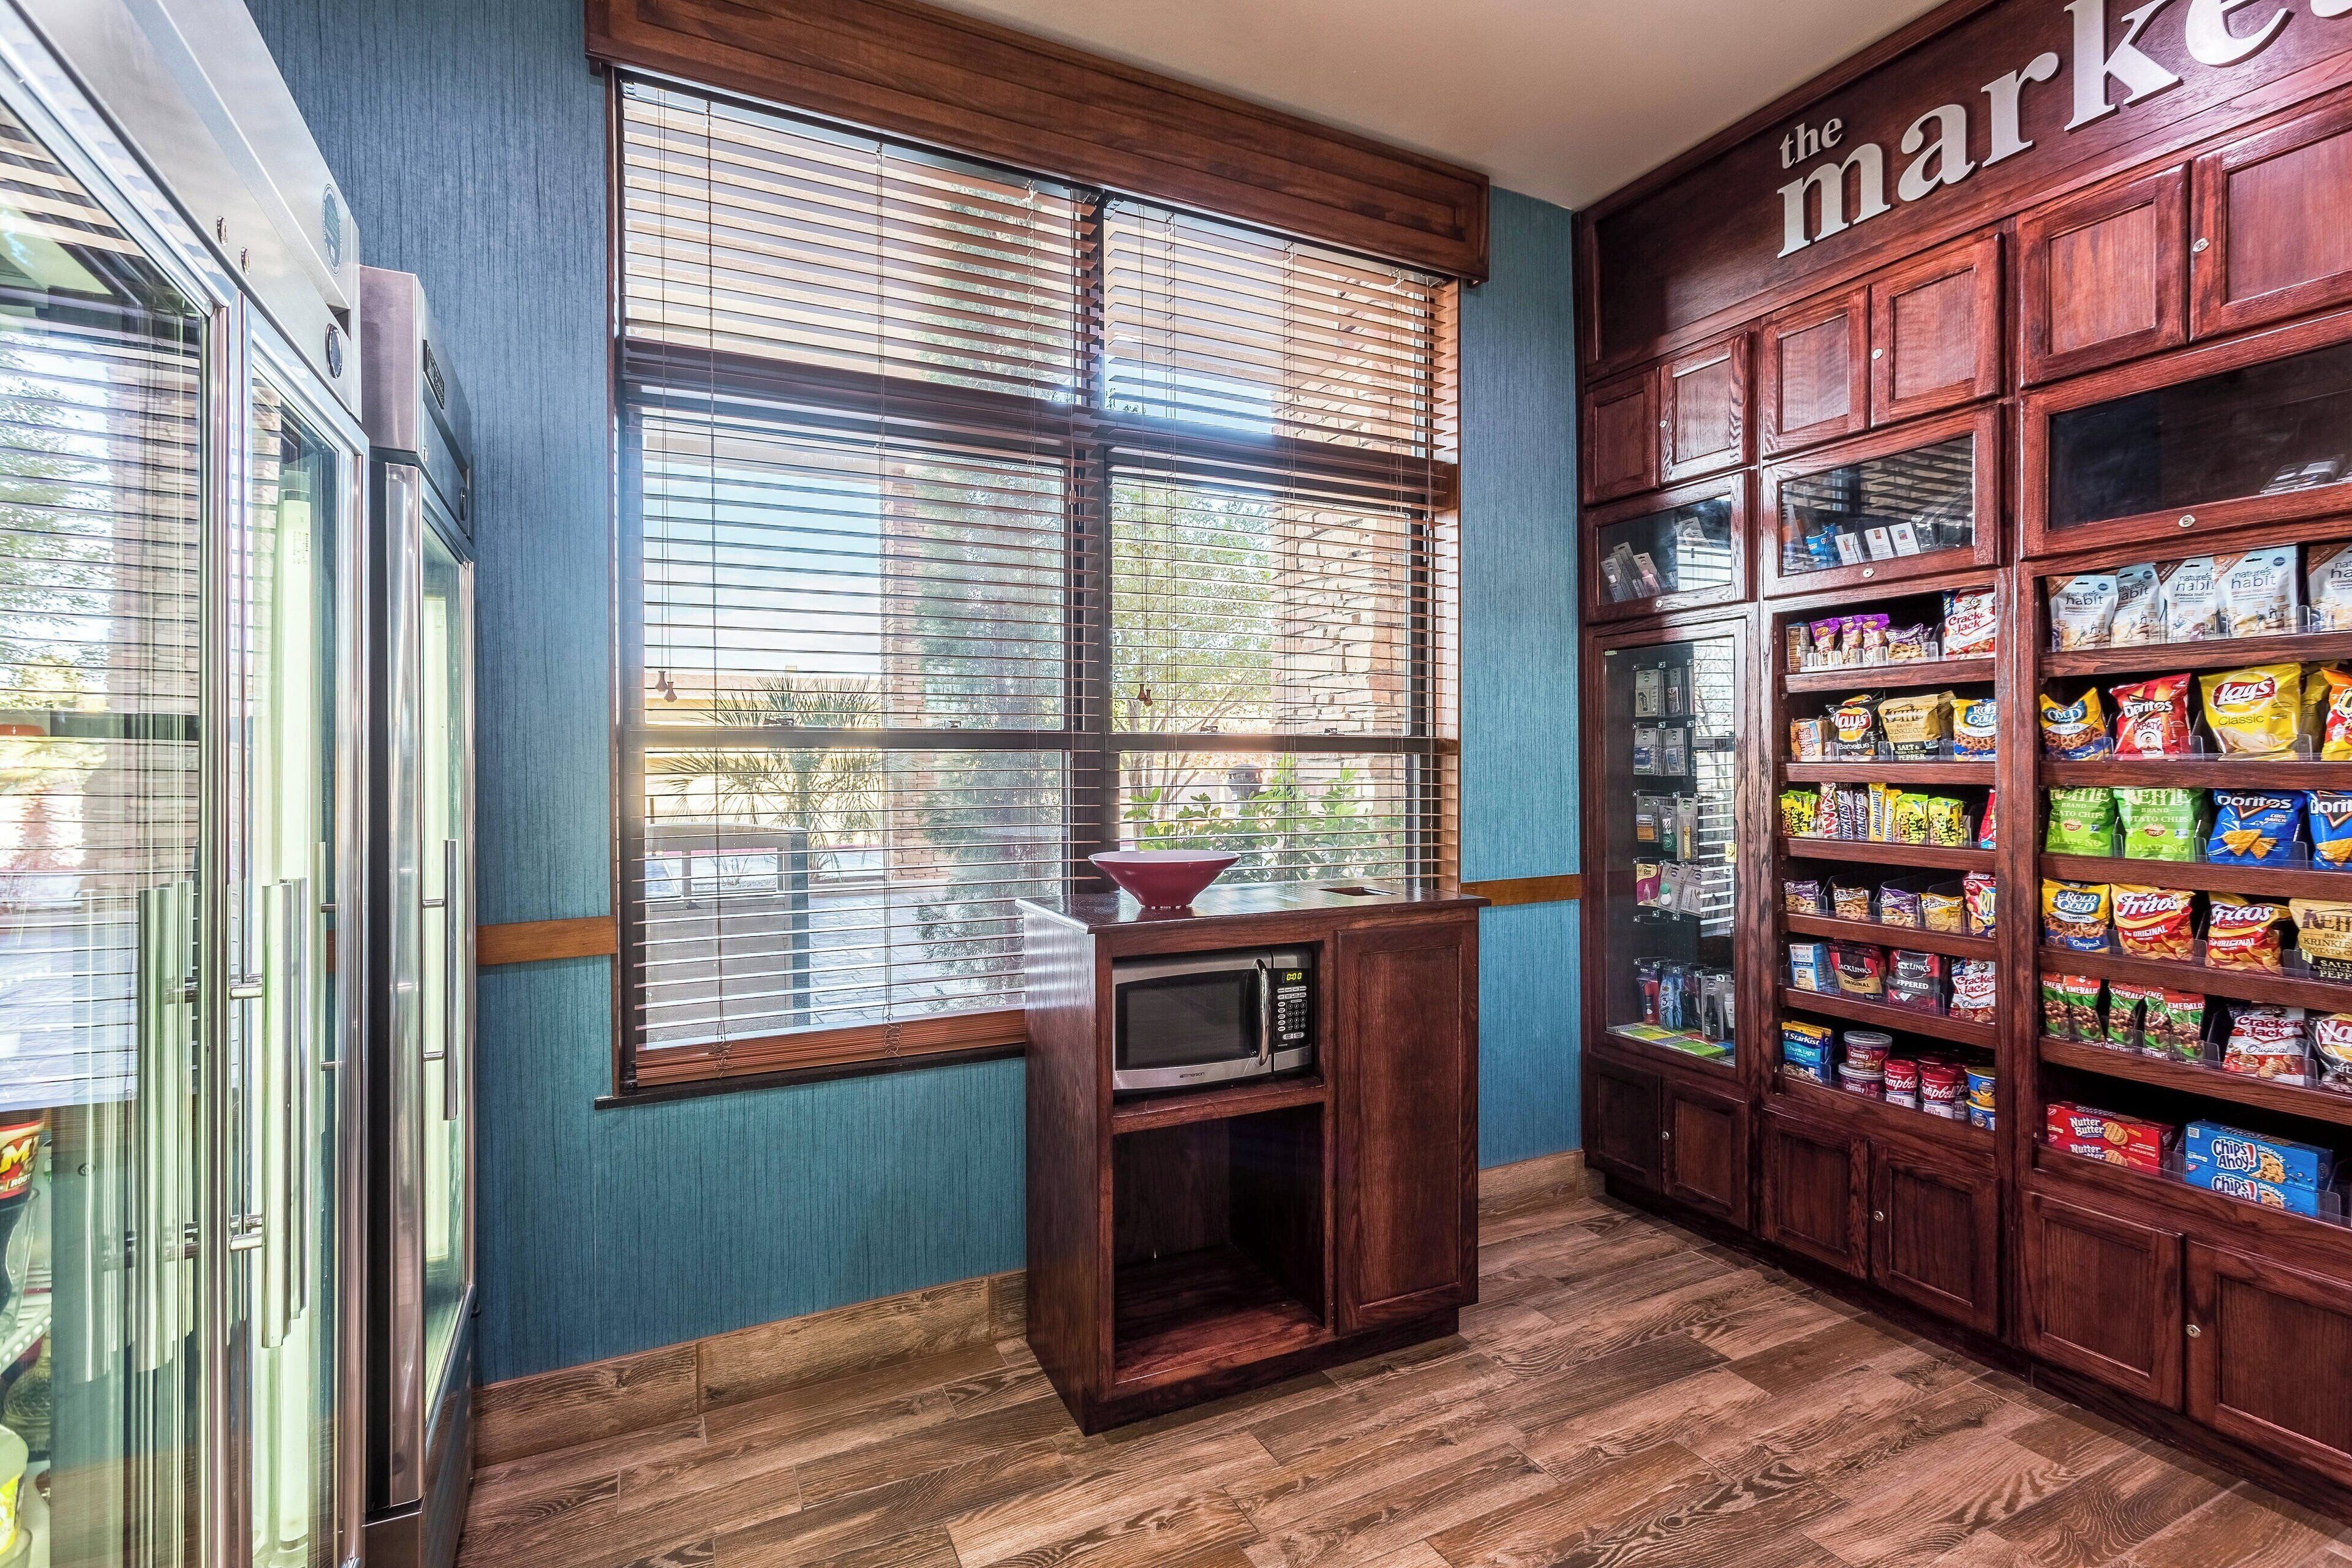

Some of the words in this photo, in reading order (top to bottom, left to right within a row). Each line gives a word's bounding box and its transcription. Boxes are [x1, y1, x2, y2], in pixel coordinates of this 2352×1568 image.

[1777, 0, 2352, 258] marke
[1779, 118, 1842, 169] the
[2179, 573, 2212, 581] nature's
[2235, 567, 2273, 579] nature's
[2119, 579, 2146, 592] ature's
[2176, 581, 2215, 591] habit
[2231, 575, 2276, 589] habit
[2066, 595, 2104, 605] habit
[1954, 620, 1981, 635] Jack
[2122, 700, 2174, 719] Doritos
[2218, 714, 2265, 726] Classic
[1839, 742, 1870, 750] Barbecue
[2217, 795, 2293, 810] Doritos
[1872, 790, 1883, 837] Butterfinger
[1900, 812, 1910, 842] PATCH
[1909, 813, 1920, 843] SOUR
[2065, 891, 2097, 903] ROLD
[2057, 900, 2095, 913] GOLD
[2117, 891, 2180, 918] Fritos
[2209, 904, 2274, 925] Fritos
[2133, 924, 2169, 938] ORIGINAL
[2072, 938, 2102, 950] Original
[2217, 937, 2255, 947] ORIGINAL
[2308, 946, 2342, 956] POTATO
[1844, 979, 1871, 988] ORIGINAL
[1955, 974, 1996, 986] Cracke
[2065, 986, 2099, 995] EMERALD
[2111, 987, 2145, 1000] EMERALD
[2167, 1002, 2204, 1011] EMERALD
[2237, 1016, 2305, 1029] Cracker
[2246, 1027, 2285, 1038] Jack
[1789, 1033, 1820, 1046] StarKist
[1787, 1045, 1803, 1054] Chunk
[2245, 1043, 2291, 1054] Original
[1850, 1051, 1870, 1061] CHUNKY
[1845, 1084, 1865, 1094] CHUNKY
[2069, 1117, 2101, 1128] Nutter
[2075, 1126, 2105, 1137] Butter
[2070, 1144, 2102, 1153] Nutter
[2212, 1140, 2248, 1157] Chips
[2256, 1144, 2286, 1164] ORIGINAL
[2212, 1176, 2248, 1194] Chips
[2258, 1182, 2288, 1201] ORIGINAL
